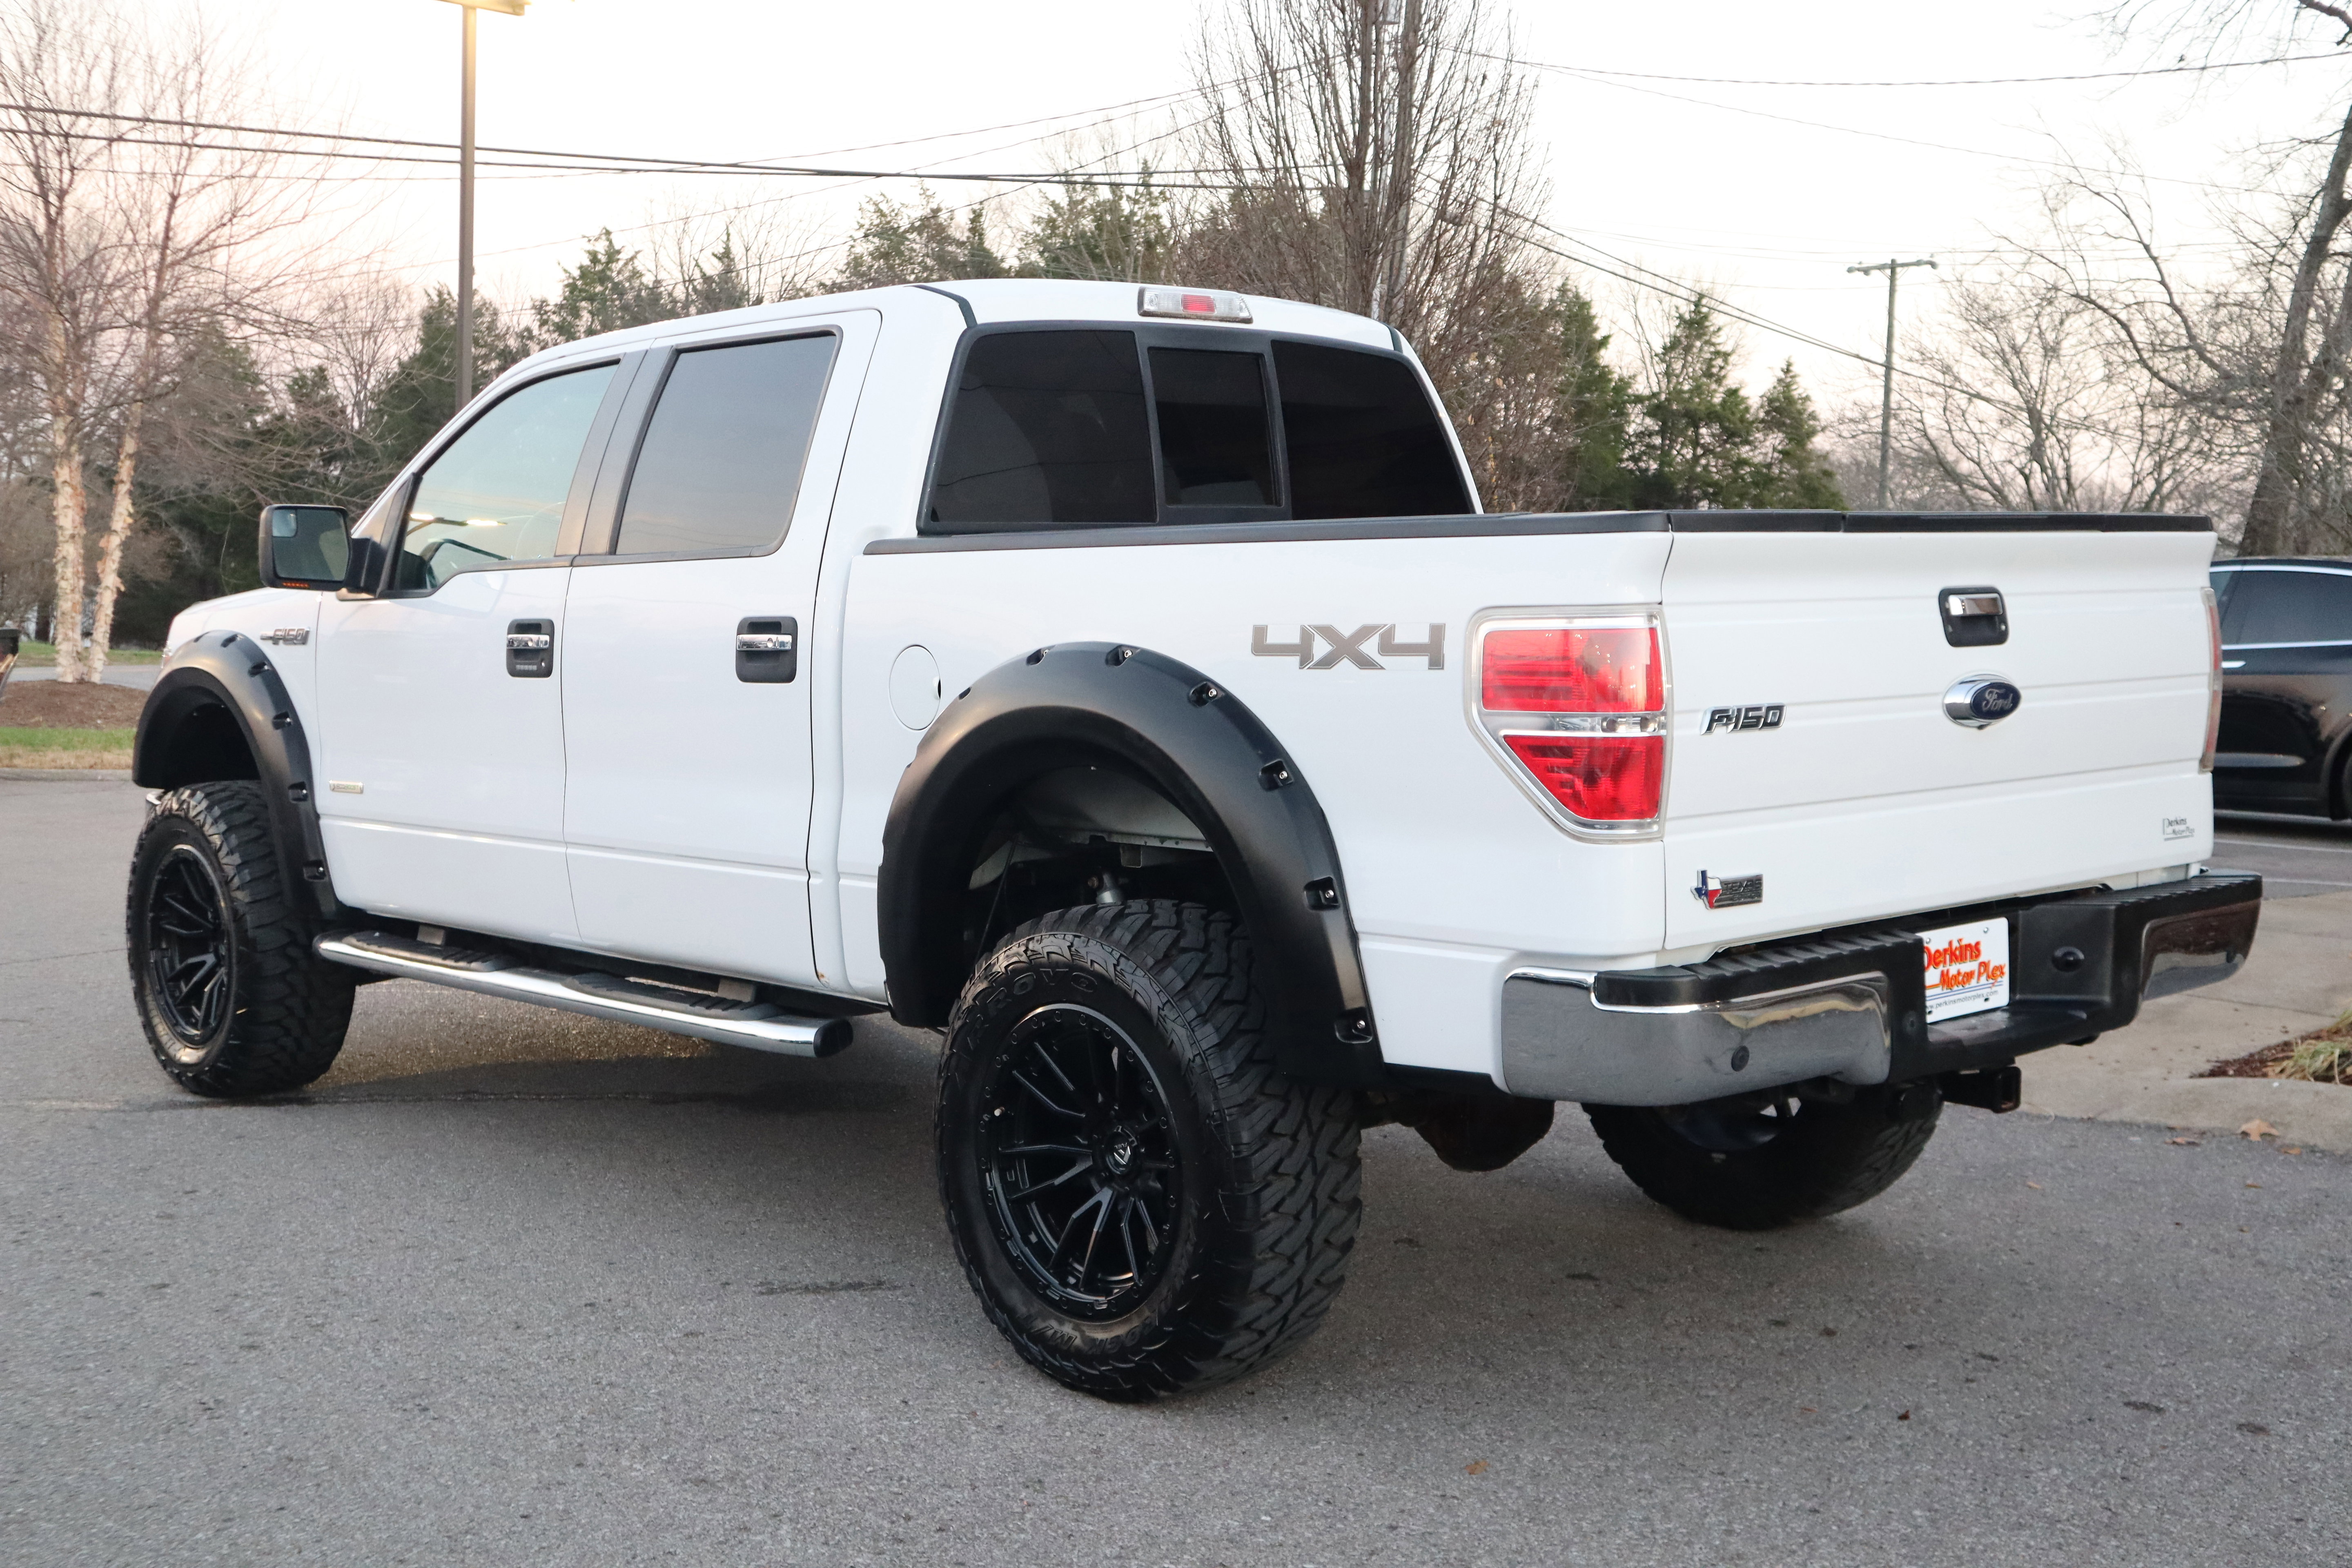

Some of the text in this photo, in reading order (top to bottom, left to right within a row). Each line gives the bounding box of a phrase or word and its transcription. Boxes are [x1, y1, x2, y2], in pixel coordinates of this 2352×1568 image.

[1982, 688, 2013, 712] Ford
[1699, 702, 1786, 735] F-150
[1940, 960, 2006, 990] Motor Plex
